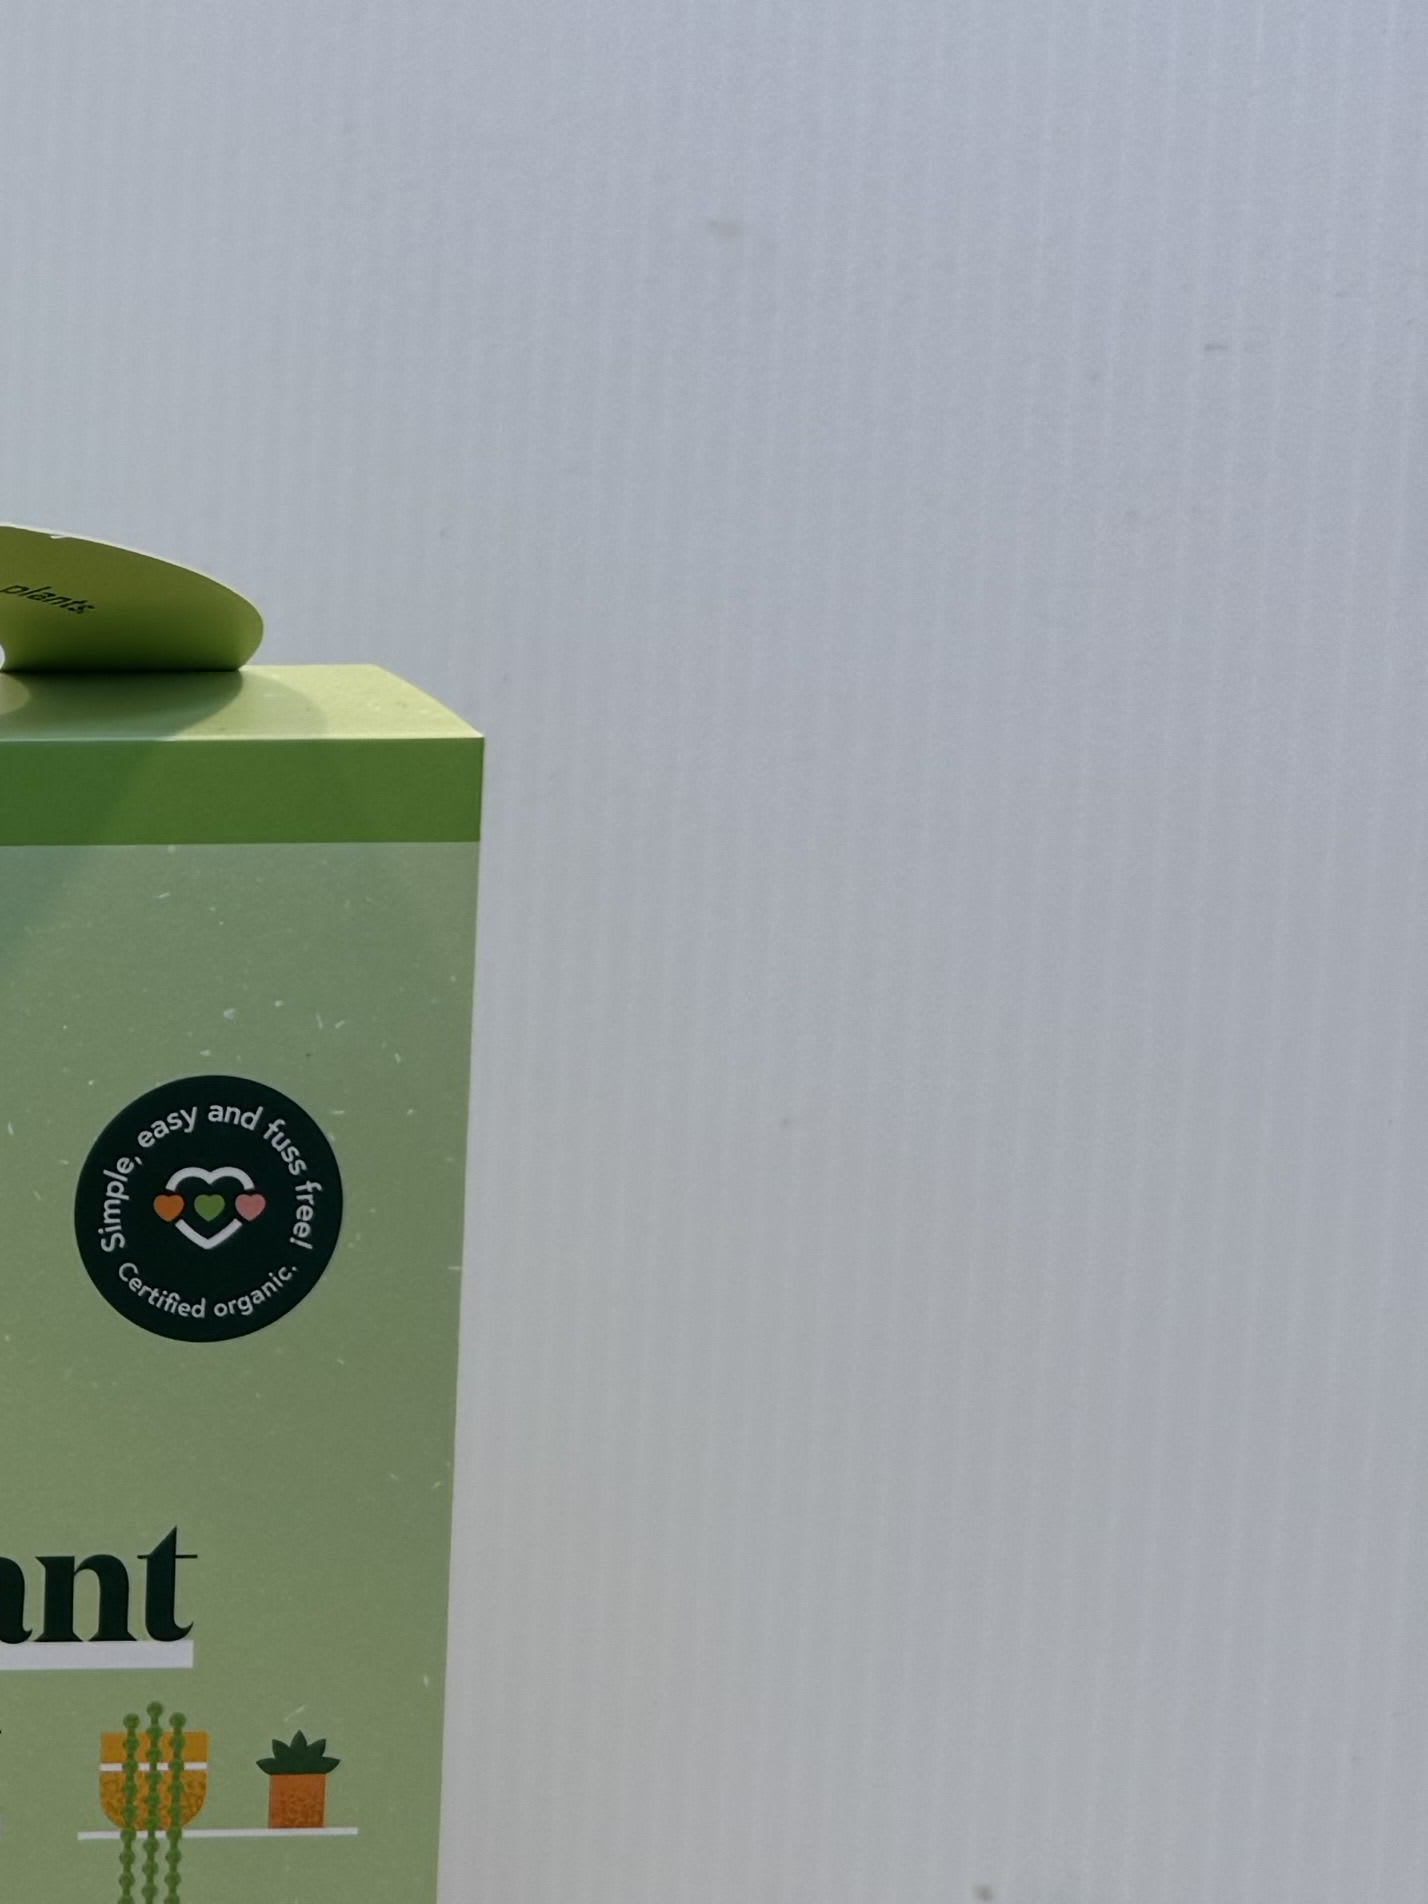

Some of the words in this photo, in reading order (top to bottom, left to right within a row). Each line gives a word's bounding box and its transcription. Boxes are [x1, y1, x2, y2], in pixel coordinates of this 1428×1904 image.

[98, 1156, 142, 1252] Simple,
[137, 1106, 197, 1147] easy
[208, 1104, 263, 1130] and
[263, 1119, 307, 1176] fuss
[290, 1180, 322, 1250] free!
[118, 1262, 206, 1318] Certified
[214, 1266, 298, 1316] organic.
